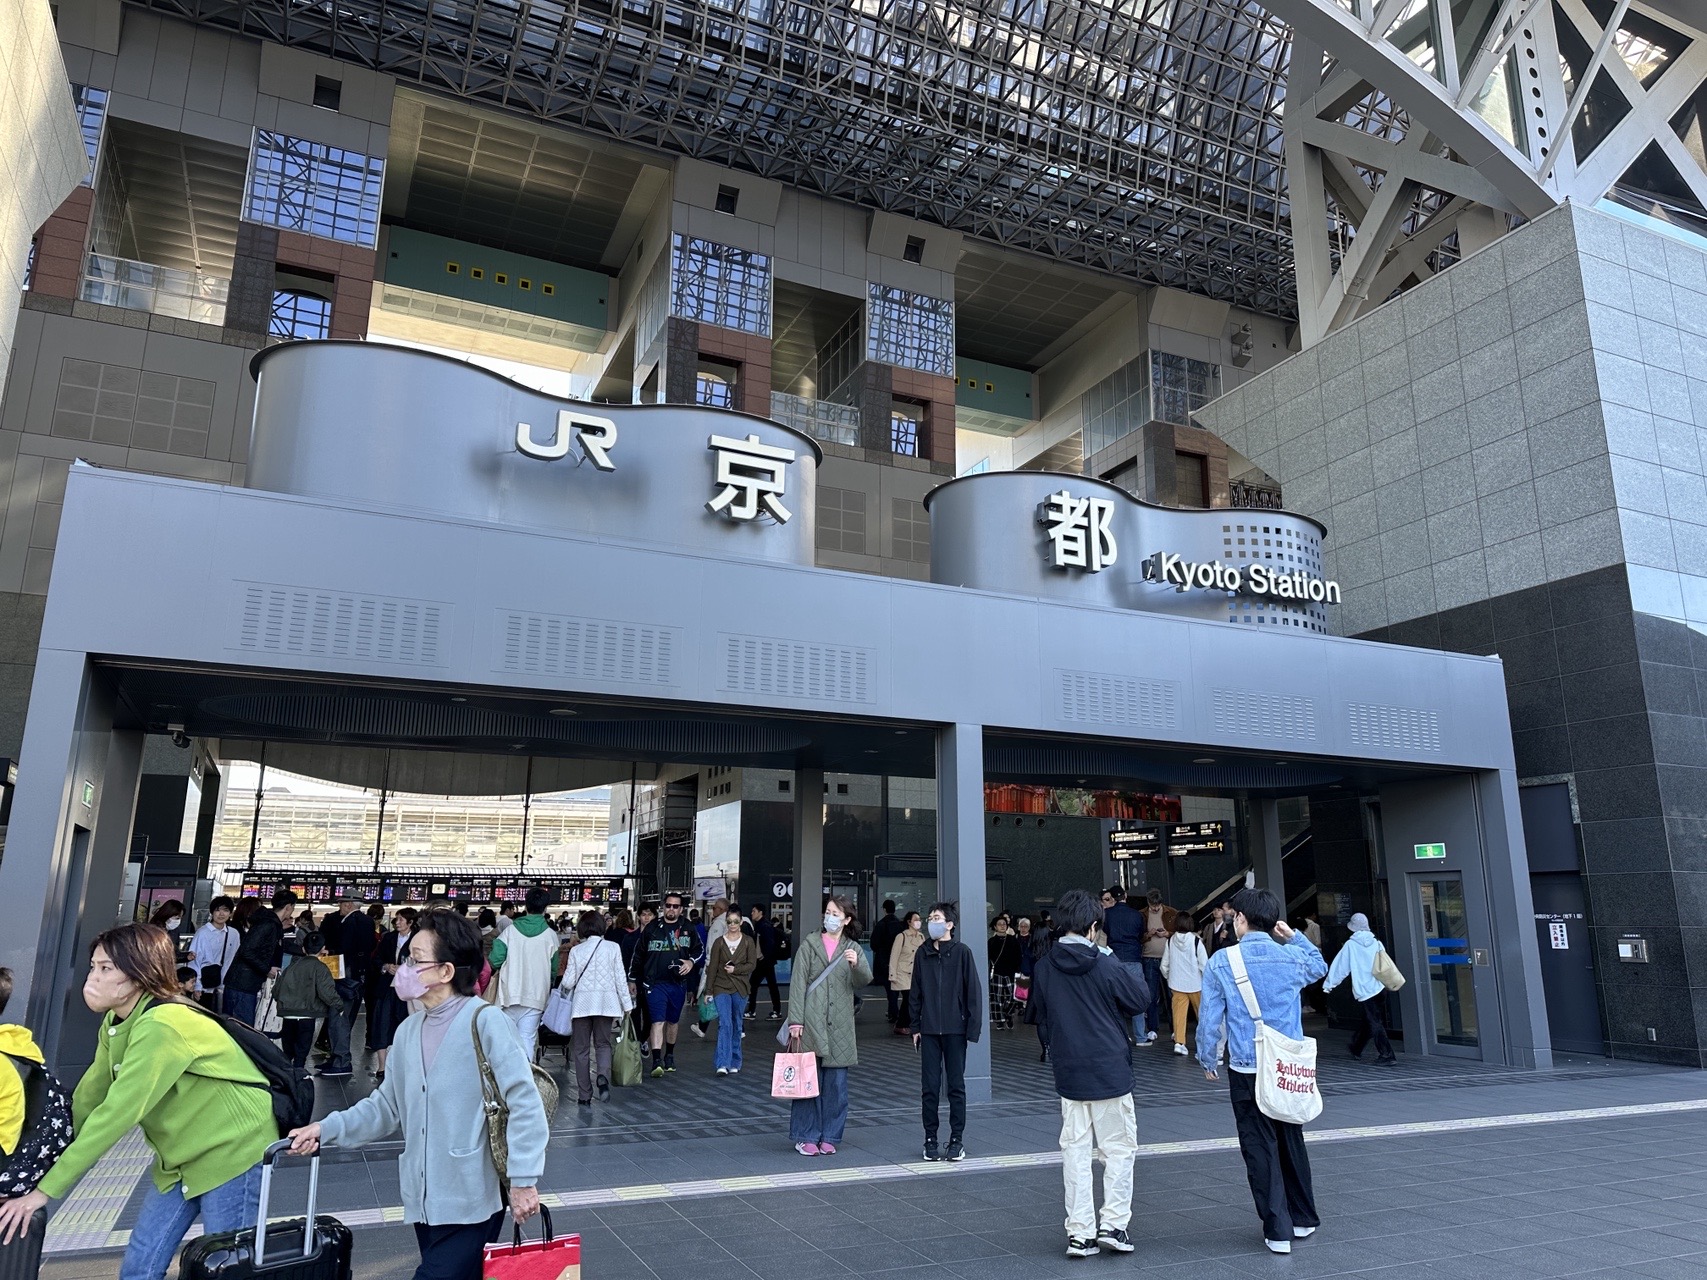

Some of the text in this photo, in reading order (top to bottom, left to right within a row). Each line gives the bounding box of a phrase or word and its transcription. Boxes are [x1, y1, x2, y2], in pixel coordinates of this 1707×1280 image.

[515, 409, 618, 472] JR
[703, 434, 796, 526] 京
[1039, 489, 1118, 574] 都
[1157, 550, 1342, 605] Kyoto Station
